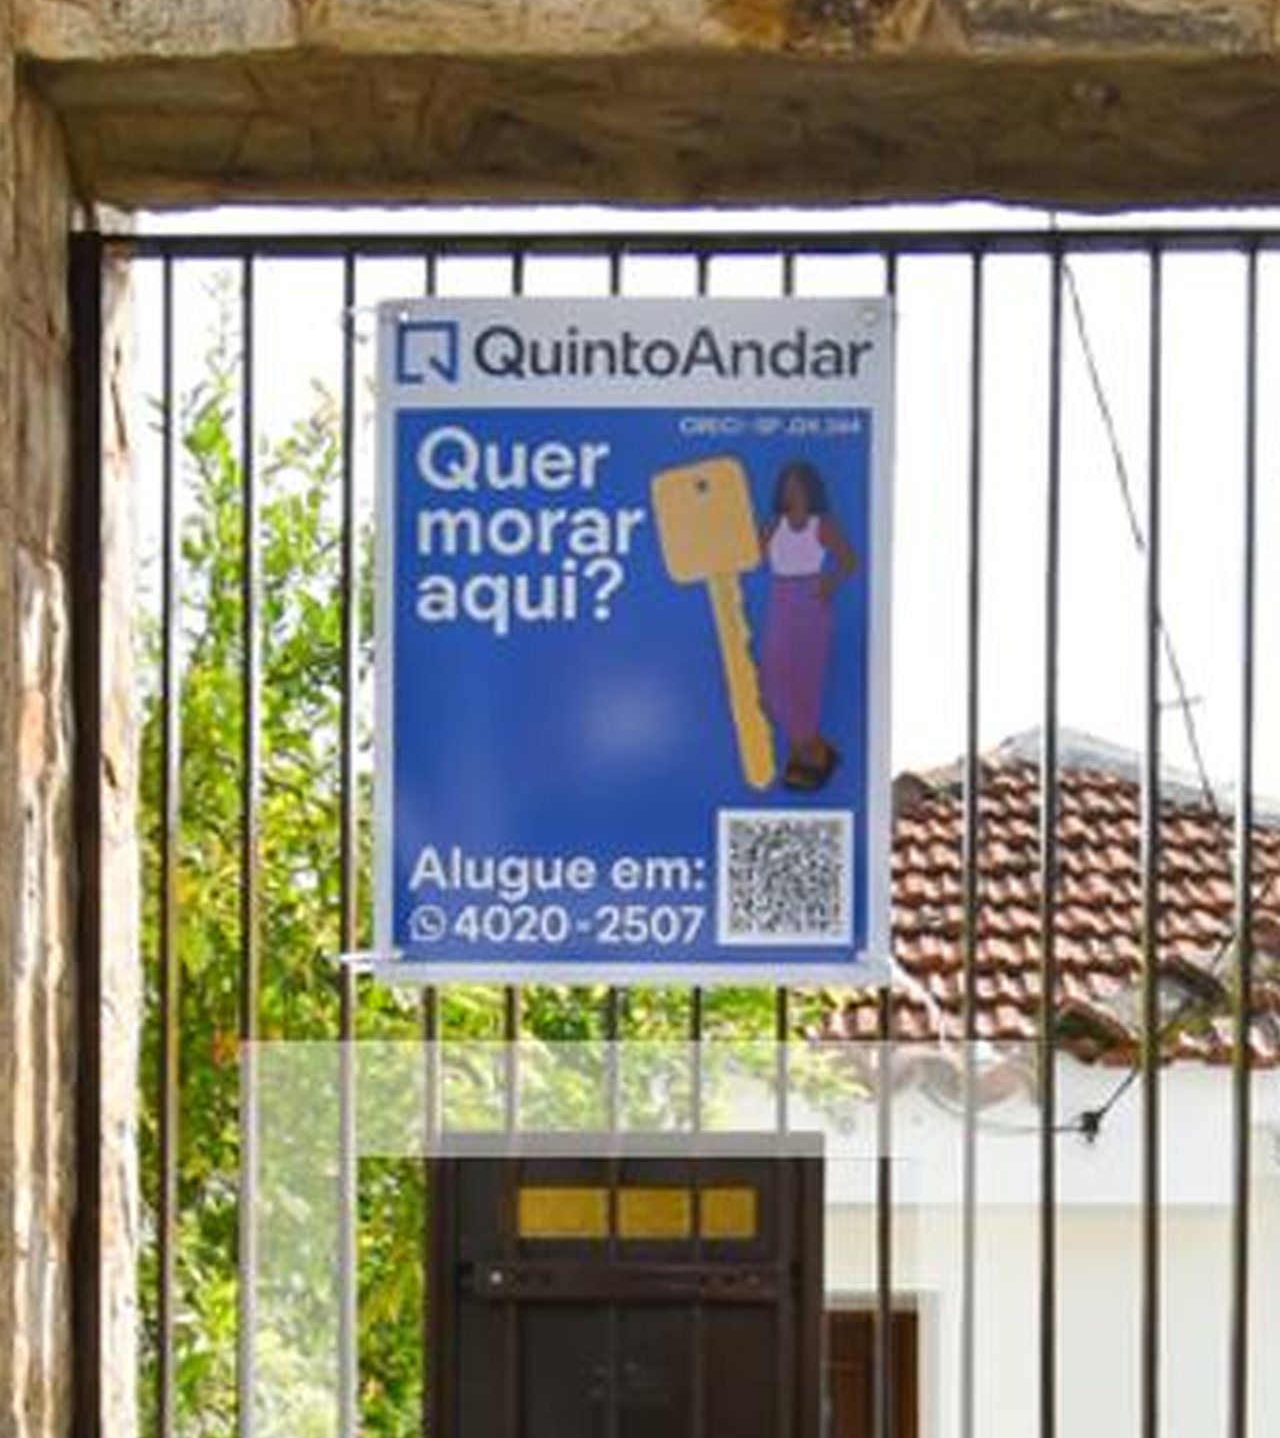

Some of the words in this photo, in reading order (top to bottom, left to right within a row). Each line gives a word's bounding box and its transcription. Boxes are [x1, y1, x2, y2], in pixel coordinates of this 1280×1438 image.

[474, 325, 873, 379] QuintoAndar
[418, 426, 610, 491] Quer
[418, 504, 645, 556] morar
[416, 561, 626, 636] aqui?
[408, 846, 597, 900] Alugue
[610, 855, 707, 891] em:
